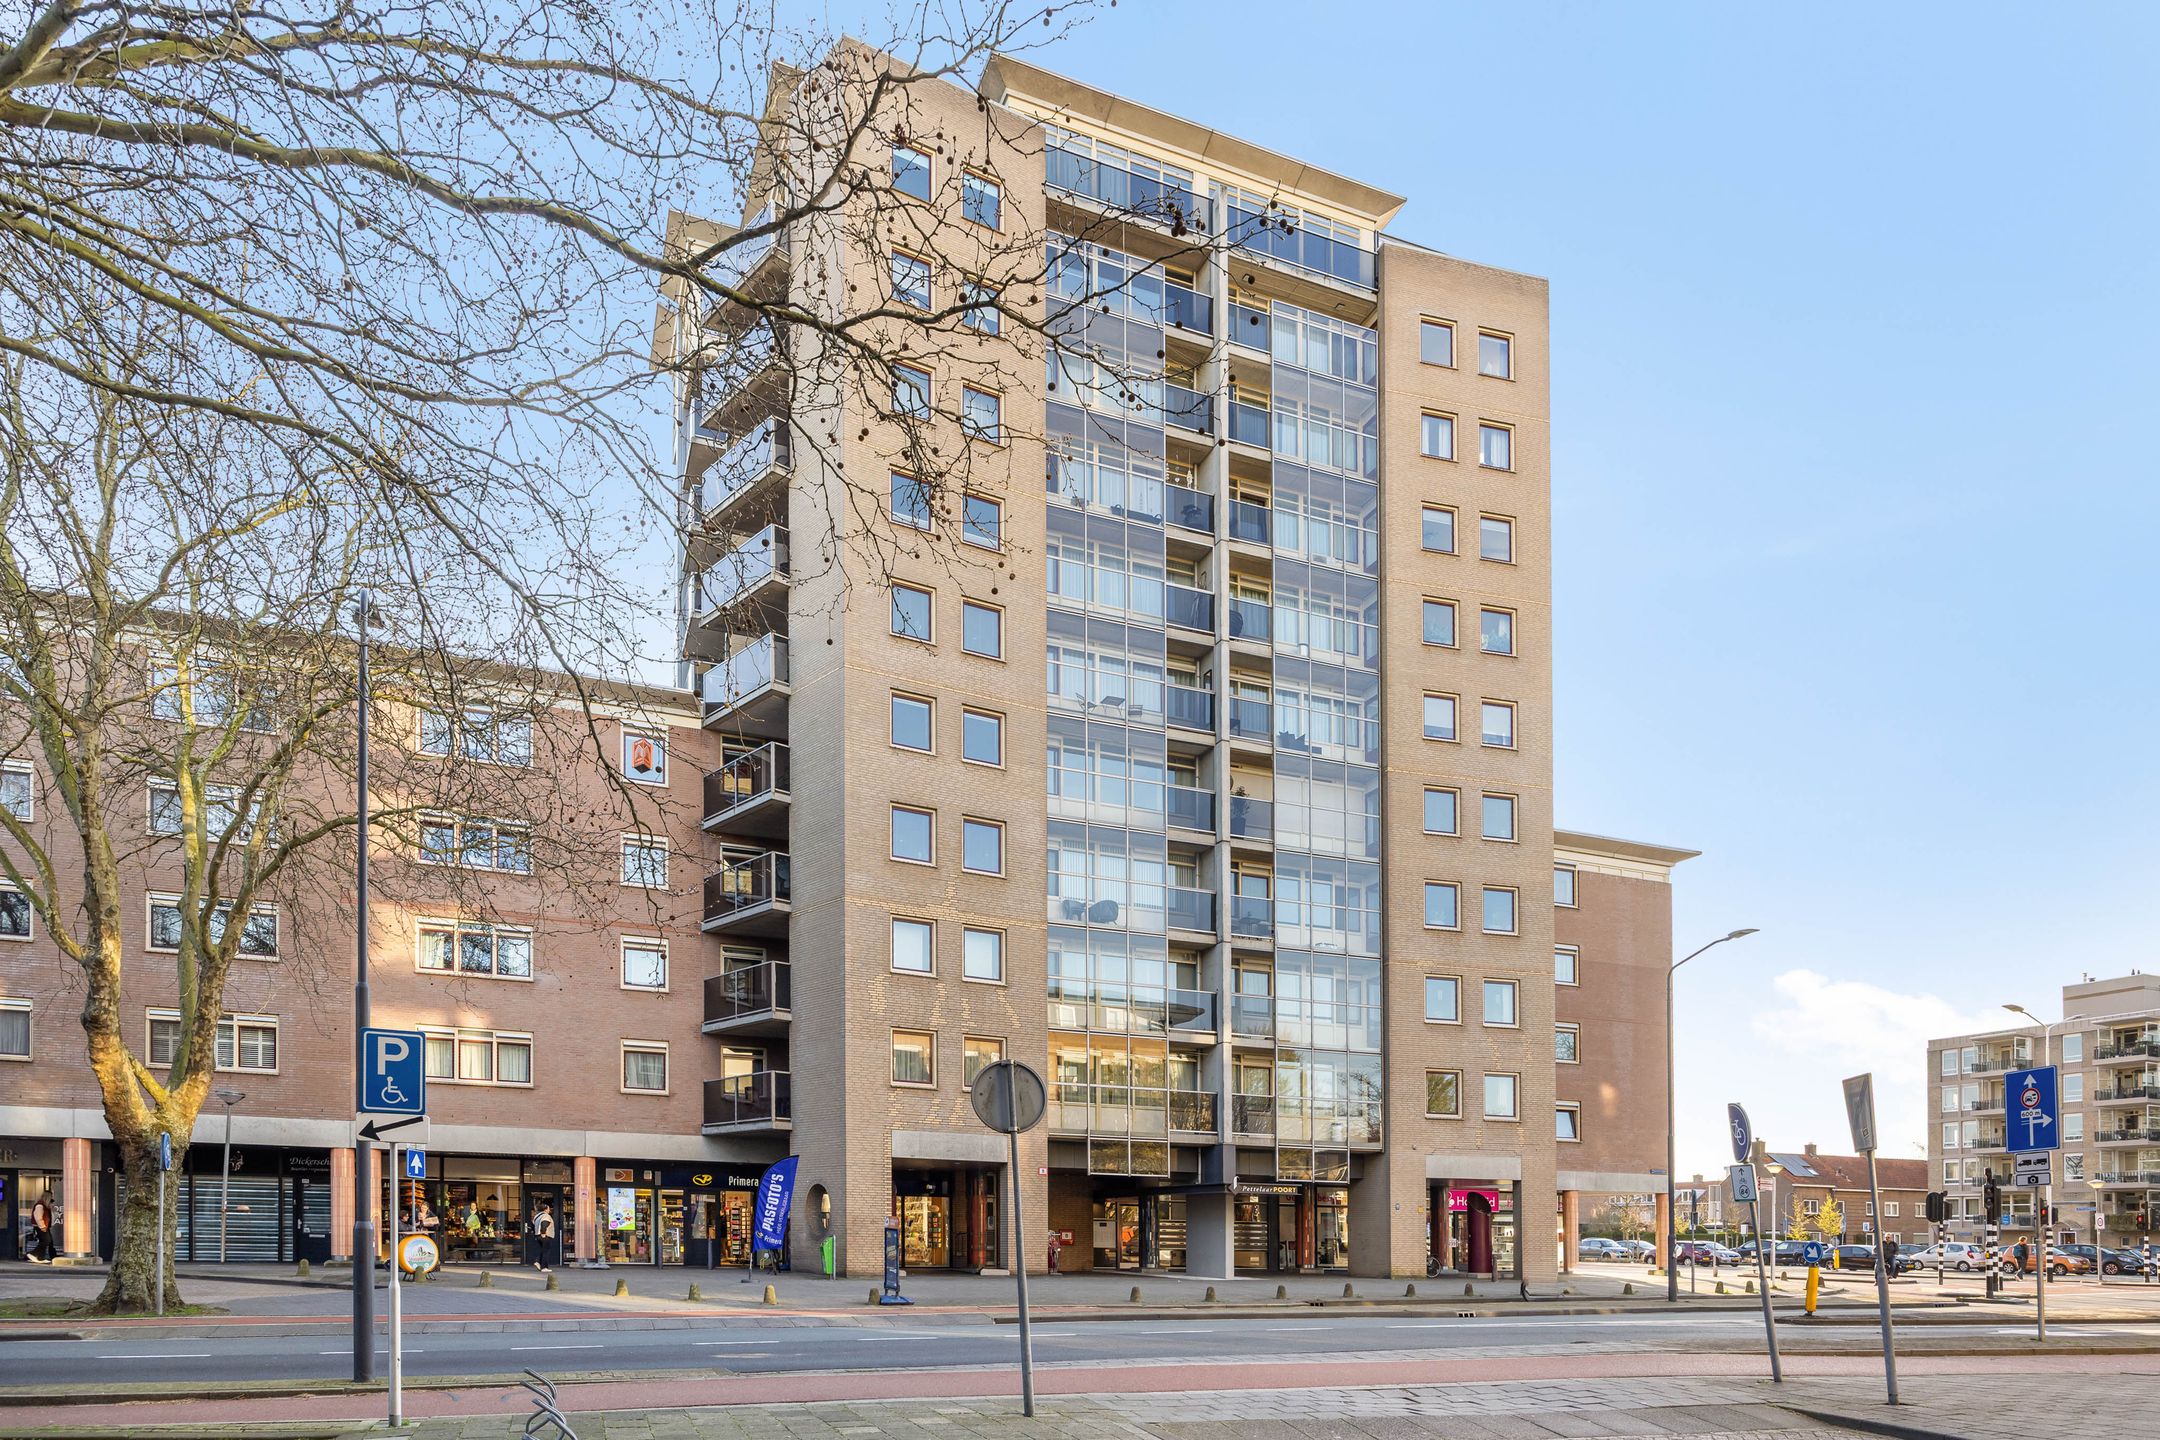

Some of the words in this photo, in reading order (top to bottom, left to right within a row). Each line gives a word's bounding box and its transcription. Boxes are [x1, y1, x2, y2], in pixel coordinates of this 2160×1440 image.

[377, 1036, 410, 1076] P
[728, 1176, 759, 1186] Primera
[762, 1173, 784, 1232] PASFOTO'S
[764, 1235, 782, 1245] Primera
